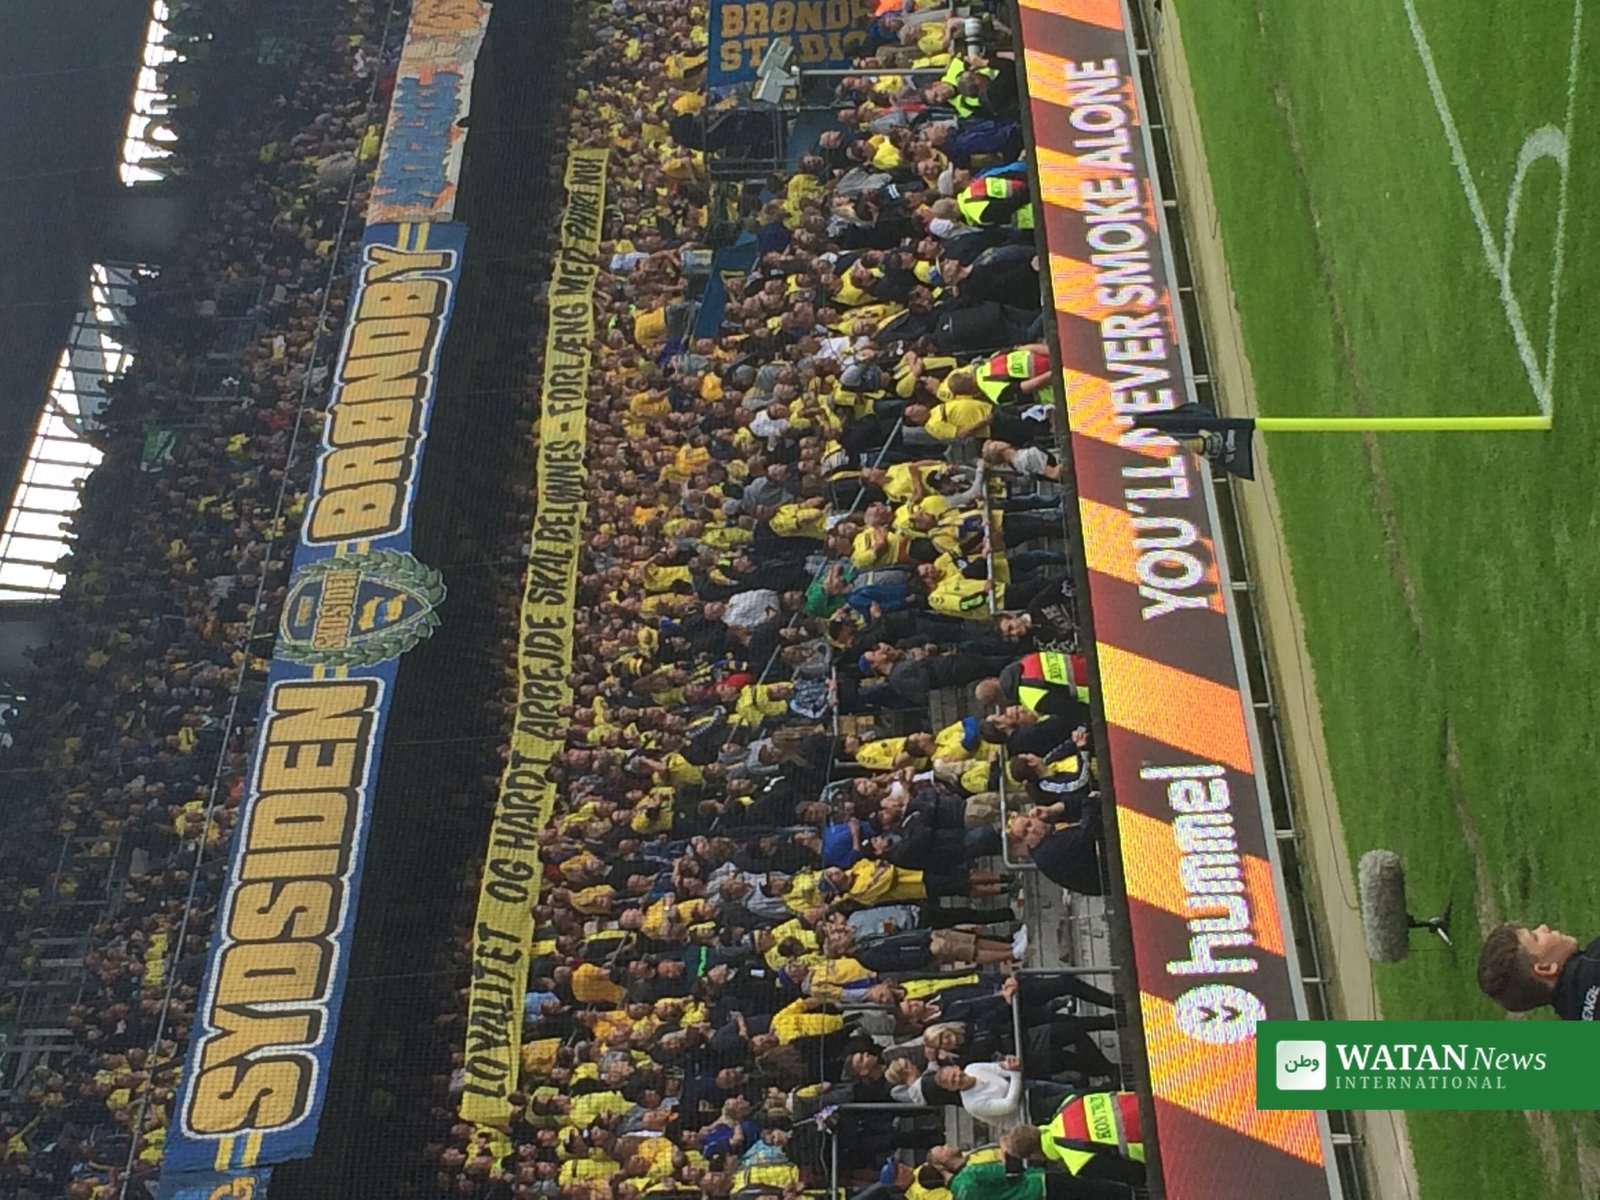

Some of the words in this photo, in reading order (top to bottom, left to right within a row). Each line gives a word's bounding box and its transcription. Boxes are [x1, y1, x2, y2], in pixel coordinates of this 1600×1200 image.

[1064, 58, 1135, 171] ALONE
[554, 246, 597, 296] MED
[1081, 177, 1157, 308] SMOKE
[547, 302, 589, 418] FORLÆNG
[1102, 311, 1181, 448] NEVER
[526, 547, 575, 606] SKAL
[1121, 455, 1209, 621] YOU'LL
[185, 680, 383, 1136] SYDSIDEN
[306, 246, 454, 543] BRØNDBY
[517, 613, 567, 742] ARBEJDE
[486, 858, 535, 904] OG
[1139, 765, 1258, 975] hummel
[463, 922, 522, 1098] LOYALITET
